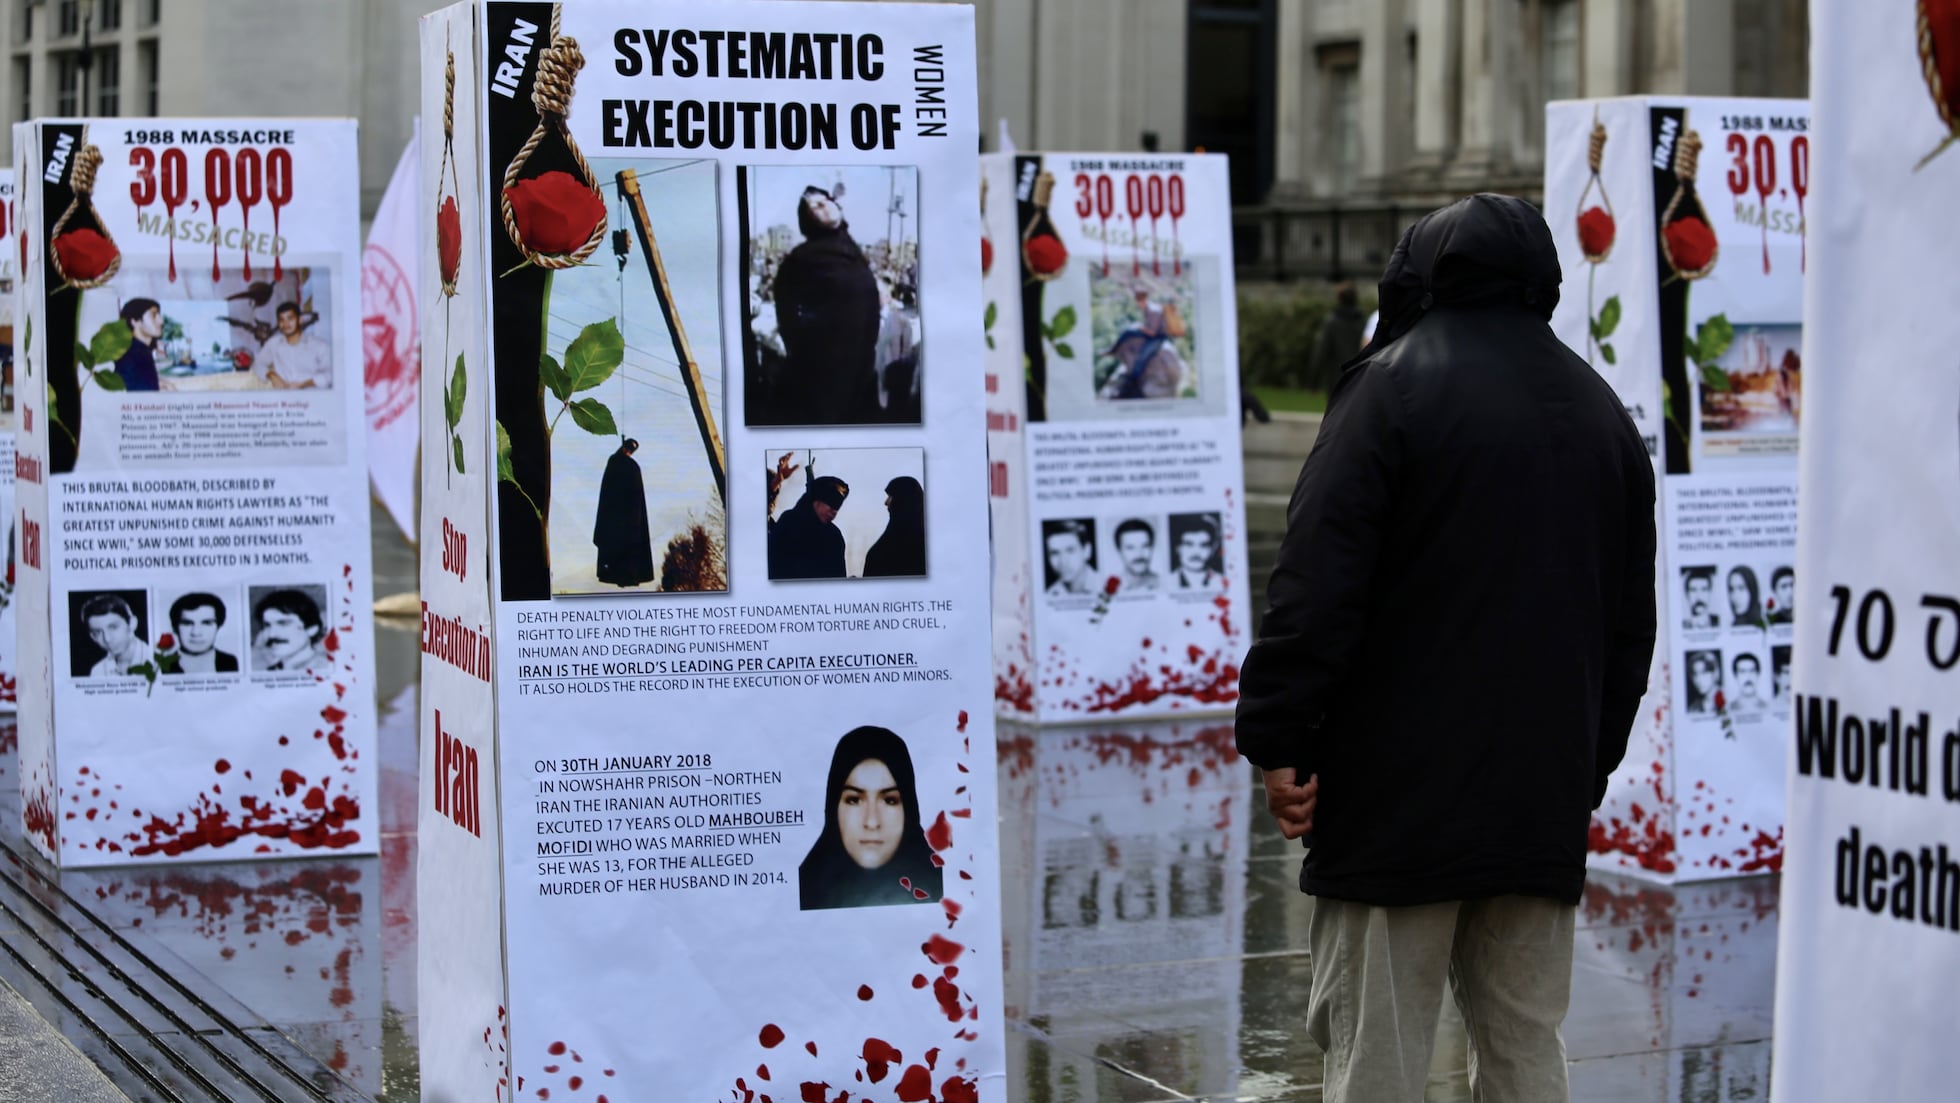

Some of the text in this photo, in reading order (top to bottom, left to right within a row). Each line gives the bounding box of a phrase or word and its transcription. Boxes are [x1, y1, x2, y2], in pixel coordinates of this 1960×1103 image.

[490, 18, 539, 99] IRAN
[614, 28, 884, 82] SYSTEMATIC
[913, 45, 948, 136] WOMEN
[602, 99, 901, 151] EXECUTION OF
[1721, 116, 1763, 130] 1988
[124, 130, 295, 144] 1988 MASSACRE
[1654, 115, 1678, 170] IRAN
[44, 132, 74, 184] IRAN
[129, 147, 293, 213] 30,000
[138, 212, 287, 257] MASSACRED
[61, 477, 275, 494] THIS BRUTAL BLOODBATH, DESCRIBED BY
[62, 495, 328, 513] INTERNATIONAL HUMAN RIGHTS LAWYERS AS "THE
[62, 513, 334, 532] GREATEST UNPUNISHED CRIME AGAINST HUMANITY
[22, 507, 41, 570] Iran
[63, 538, 93, 551] SINCE
[136, 536, 162, 549] SAW
[163, 535, 194, 548] SOME
[198, 534, 231, 548] 30,000
[232, 533, 303, 547] DEFENSELESS
[442, 517, 467, 583] Stop
[63, 551, 313, 570] POLITICAL PRISONERS EXECUTED IN 3 MONTHS.
[517, 599, 952, 623] DEATH PENALTY VIOLATES THE MOST FUNDAMENTAL HUMAN RIGHTS .THE
[1827, 584, 1895, 662] 10
[517, 617, 940, 640] RIGHT TO LIFE AND THE RIGHT TO FREEDOM FROM TORTURE AND CRUEL
[421, 601, 490, 682] Execution in
[518, 639, 768, 658] INHUMAN AND DEGRADING PUNISHMENT
[518, 664, 552, 677] IRAN
[556, 663, 568, 676] IS
[571, 662, 598, 676] THE
[671, 658, 733, 672] LEADING
[737, 657, 763, 670] PER
[766, 655, 815, 670] CAPITA
[819, 652, 917, 669] EXECUTIONER.
[519, 668, 952, 695] IT ALSO HOLDS THE RECORD IN THE EXECUTION OF WOMEN AND MINORS.
[1796, 693, 1930, 797] World
[434, 709, 481, 839] Iran
[534, 753, 711, 773] ON 30TH JANUARY 2018
[539, 780, 553, 793] IN
[558, 776, 644, 792] NOWSHAHR
[648, 774, 700, 788] PRISON
[536, 791, 761, 814] IRAN THE IRANIAN AUTHORITIES
[537, 809, 804, 834] EXCUTED 17 YEARS OLD MAHBOUBEH
[537, 831, 780, 855] MOFIDI WHO WAS MARRIED WHEN
[538, 852, 753, 875] SHE WAS 13, FOR THE ALLEGED
[539, 871, 787, 896] MURDER OF HER HUSBAND IN 2014.
